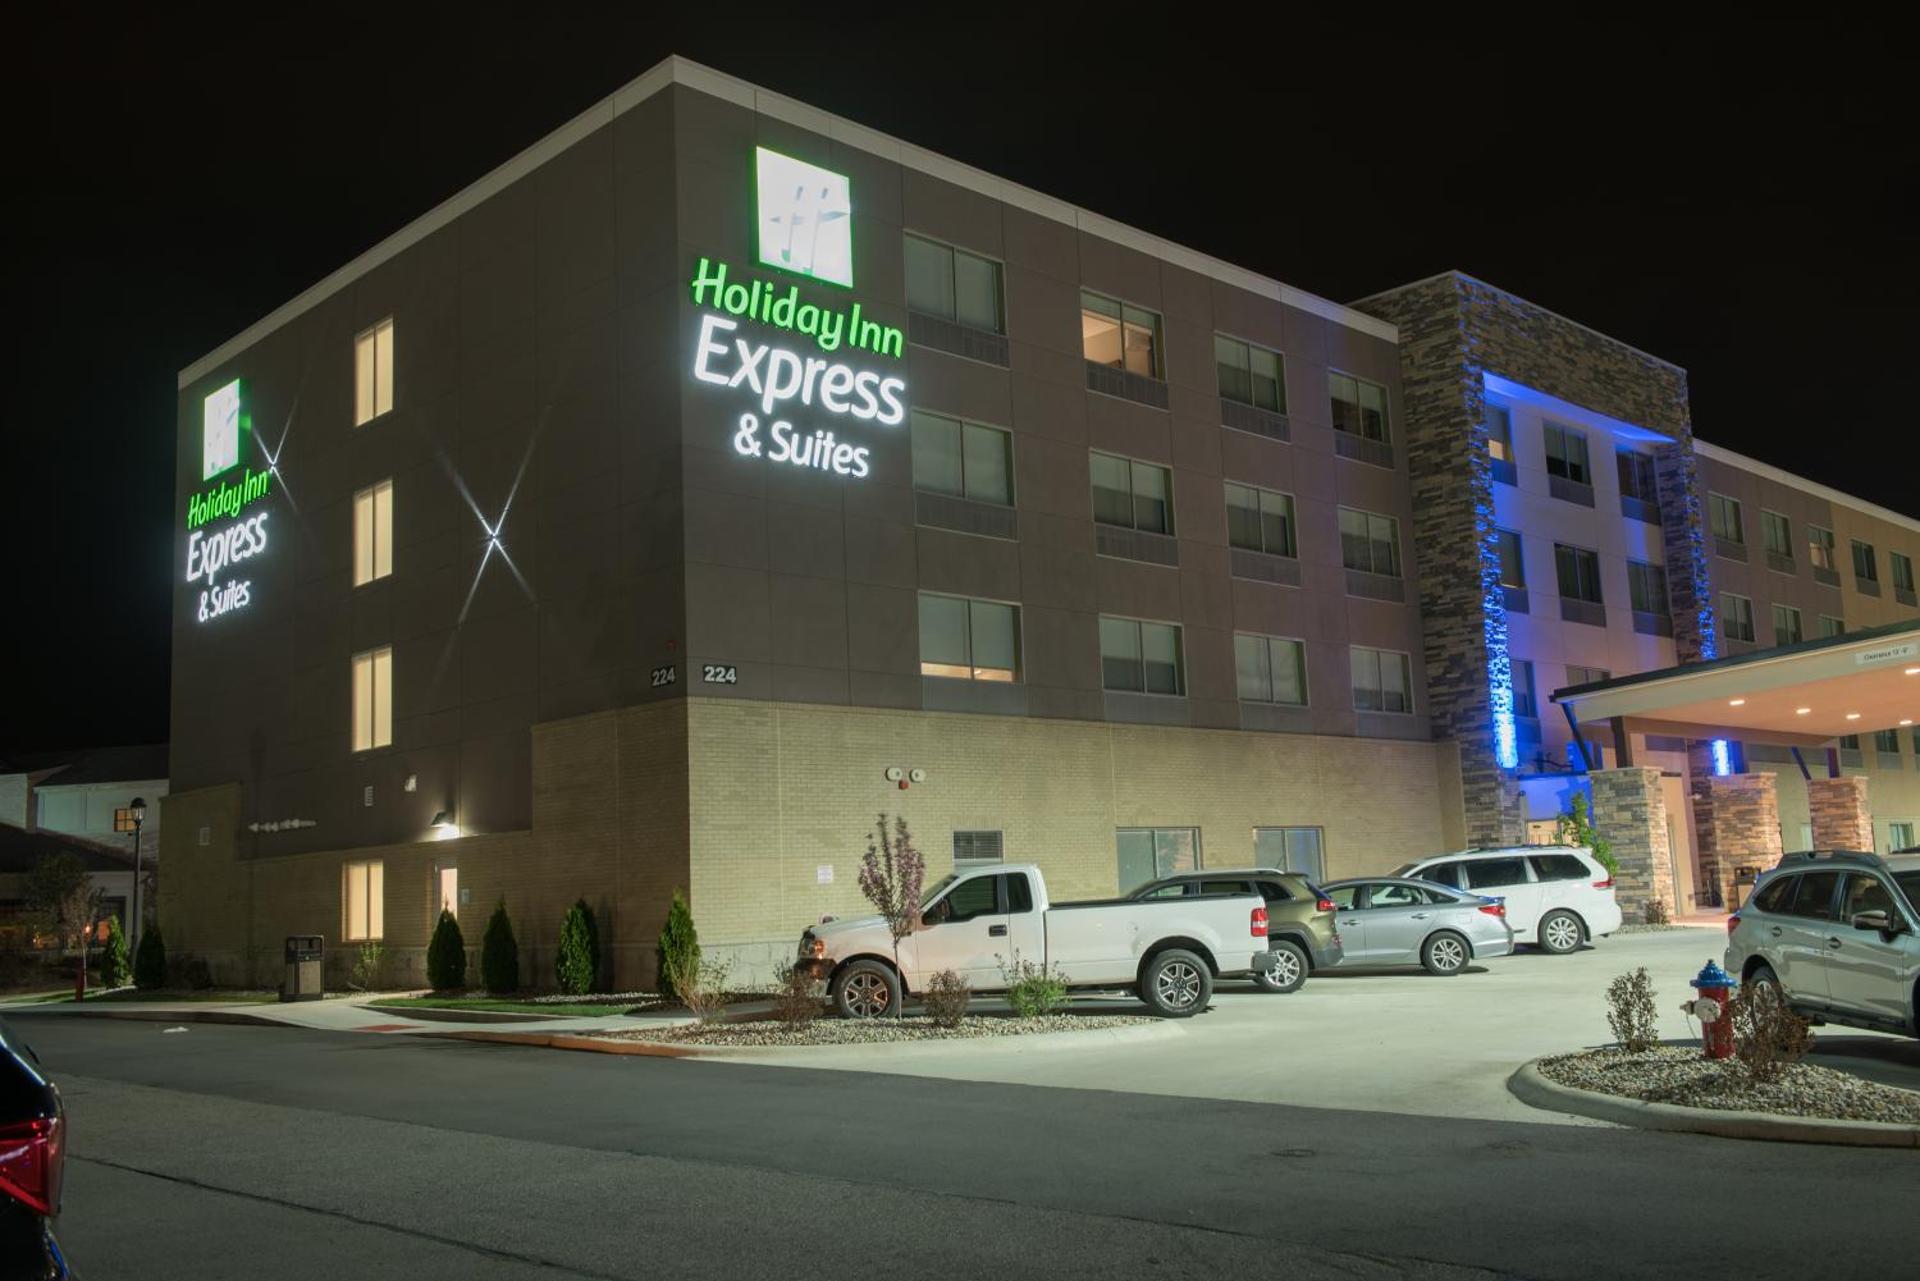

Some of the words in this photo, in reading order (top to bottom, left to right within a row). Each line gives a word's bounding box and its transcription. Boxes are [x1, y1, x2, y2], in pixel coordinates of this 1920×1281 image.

[692, 258, 844, 350] Holiday
[849, 303, 903, 357] Inn
[694, 313, 906, 425] Express
[734, 413, 761, 457] &
[768, 420, 869, 478] Suites
[188, 483, 243, 530] Holiday
[243, 468, 268, 503] Inn
[186, 512, 268, 586] Express
[198, 591, 208, 622] &
[209, 579, 250, 618] Suites
[652, 667, 676, 687] 224
[704, 666, 736, 683] 224
